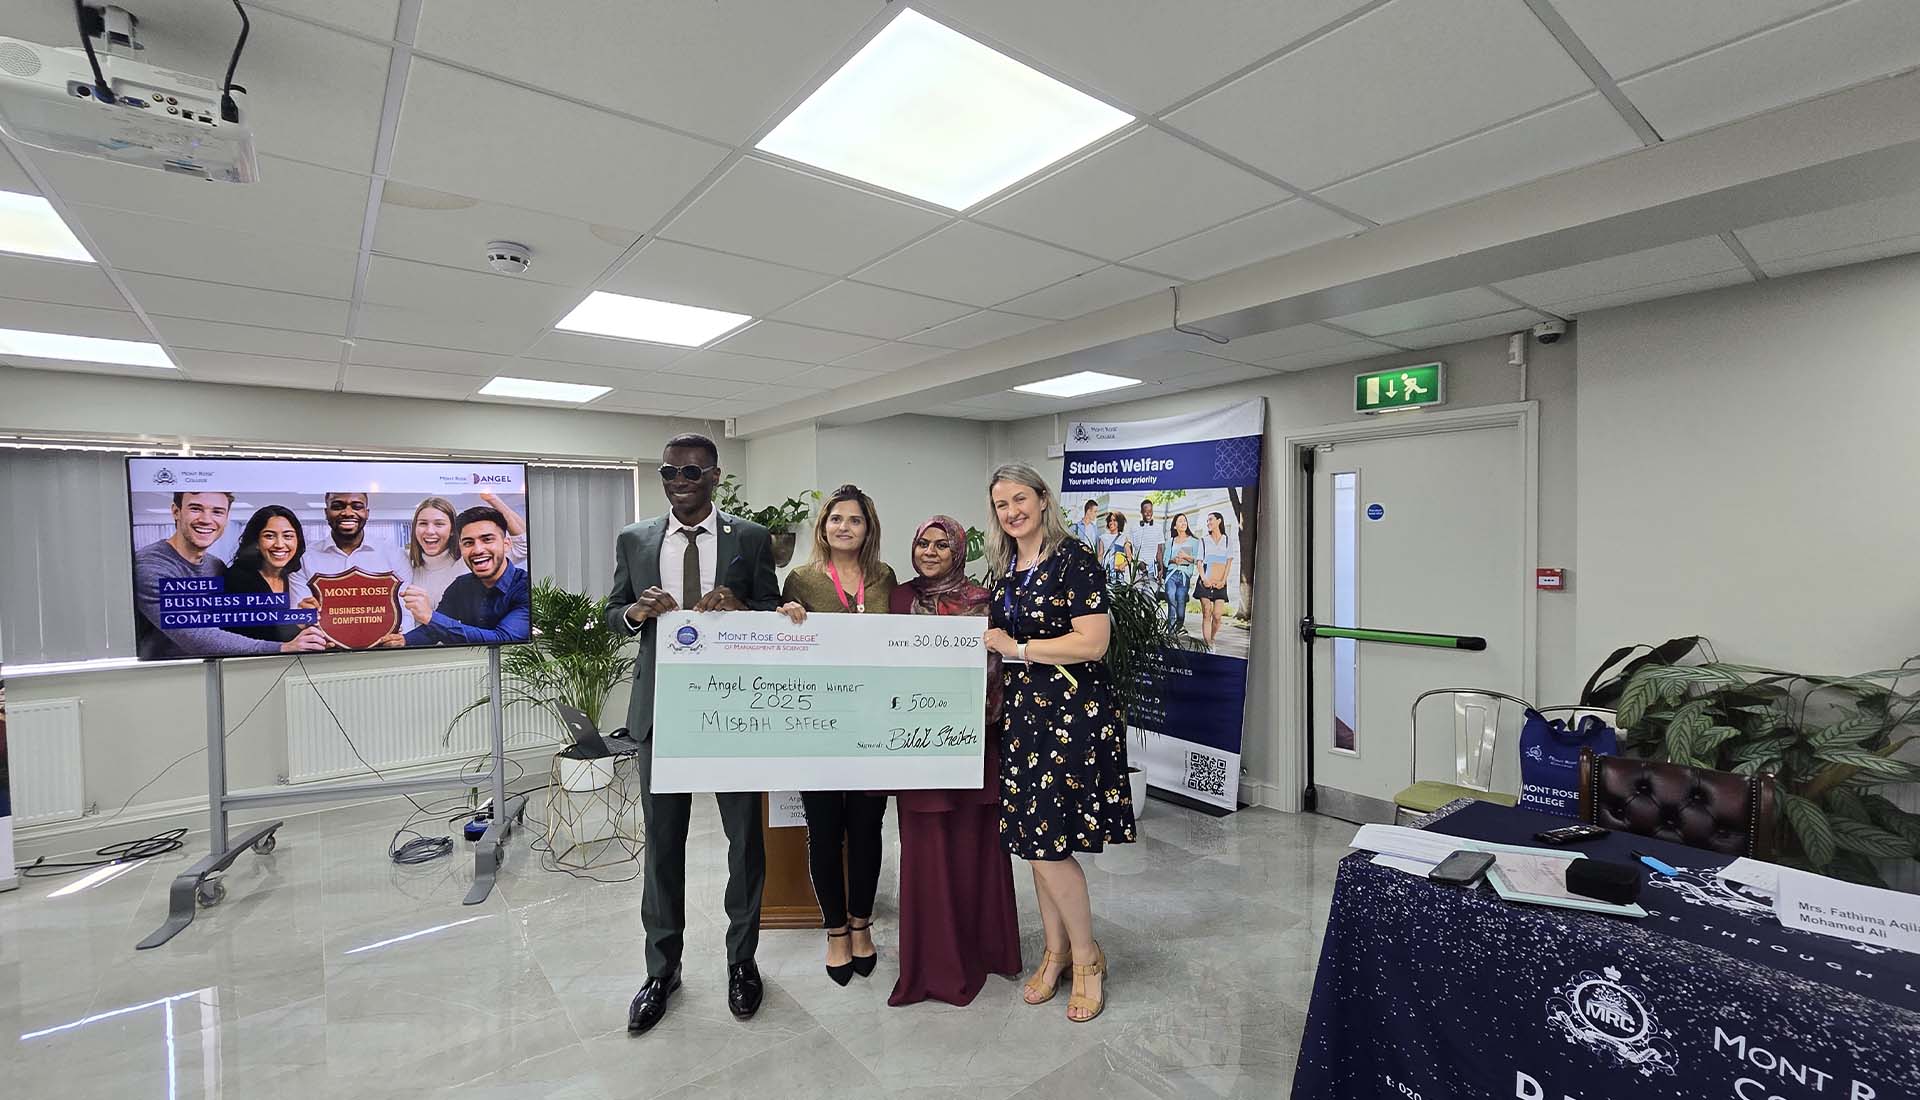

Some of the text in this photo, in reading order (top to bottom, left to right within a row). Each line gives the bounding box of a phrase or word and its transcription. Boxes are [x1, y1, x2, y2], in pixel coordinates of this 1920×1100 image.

[1069, 457, 1174, 474] Student Welfare
[481, 475, 512, 483] ANGEL
[1068, 478, 1081, 486] Your
[1082, 476, 1114, 486] well-being
[1114, 476, 1120, 485] is
[1132, 475, 1157, 486] priority
[163, 580, 218, 592] ANGEL
[324, 586, 389, 597] MONT ROSE
[164, 594, 286, 608] BUSINESS PLAN
[328, 606, 386, 615] BUSINESS PLAN
[164, 611, 314, 625] COMPETITION 2025
[332, 615, 383, 625] COMPETITION
[718, 631, 747, 640] MONT
[750, 632, 773, 641] ROSE
[912, 634, 981, 648] 30.06.2025
[752, 676, 817, 695] Competition
[750, 692, 814, 710] 2025
[890, 693, 948, 712] £ 500.00
[702, 709, 840, 732] MISBAH SAFEER
[1523, 793, 1566, 808] COLLEGE
[1552, 788, 1580, 800] ROSE
[1798, 901, 1826, 915] Mrs.
[1830, 907, 1886, 926] Fathima
[1799, 913, 1887, 939] Mohamed Ali
[1702, 923, 1873, 979] THROUGH
[1585, 1000, 1636, 1034] MRC
[1714, 1026, 1834, 1092] MONT
